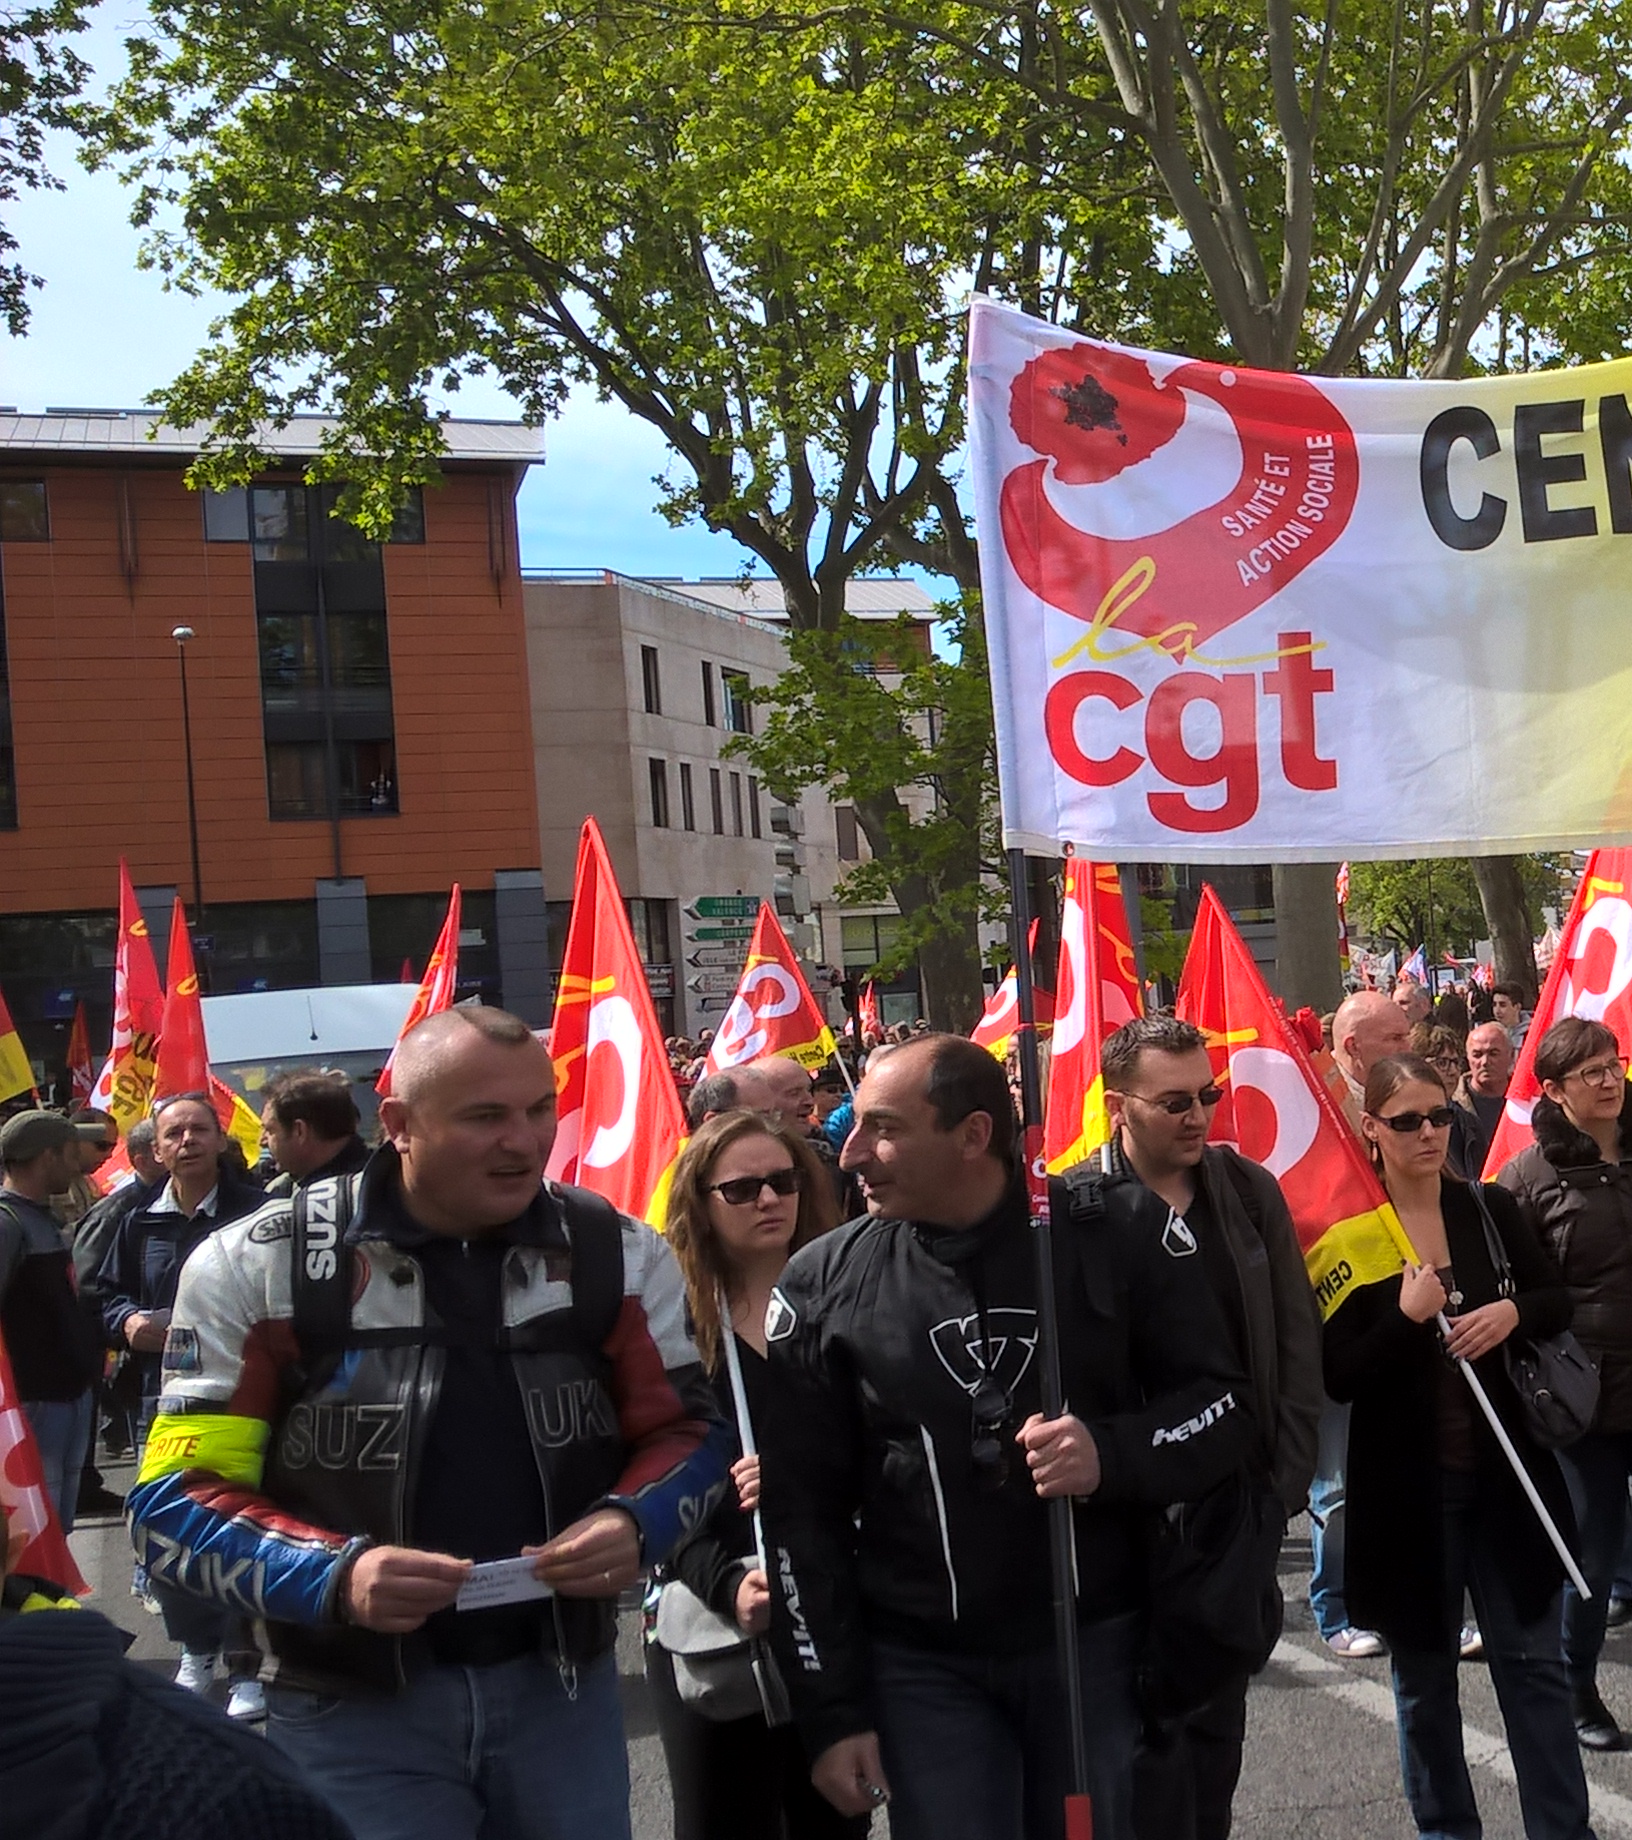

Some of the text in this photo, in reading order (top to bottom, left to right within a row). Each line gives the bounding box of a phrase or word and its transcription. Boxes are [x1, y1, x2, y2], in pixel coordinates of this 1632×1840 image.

[1221, 452, 1291, 538] SANTÉ ET
[1236, 433, 1336, 588] ACTION SOCIALE
[1052, 555, 1328, 668] la
[1044, 631, 1338, 834] cgt
[306, 1177, 338, 1281] SUZU
